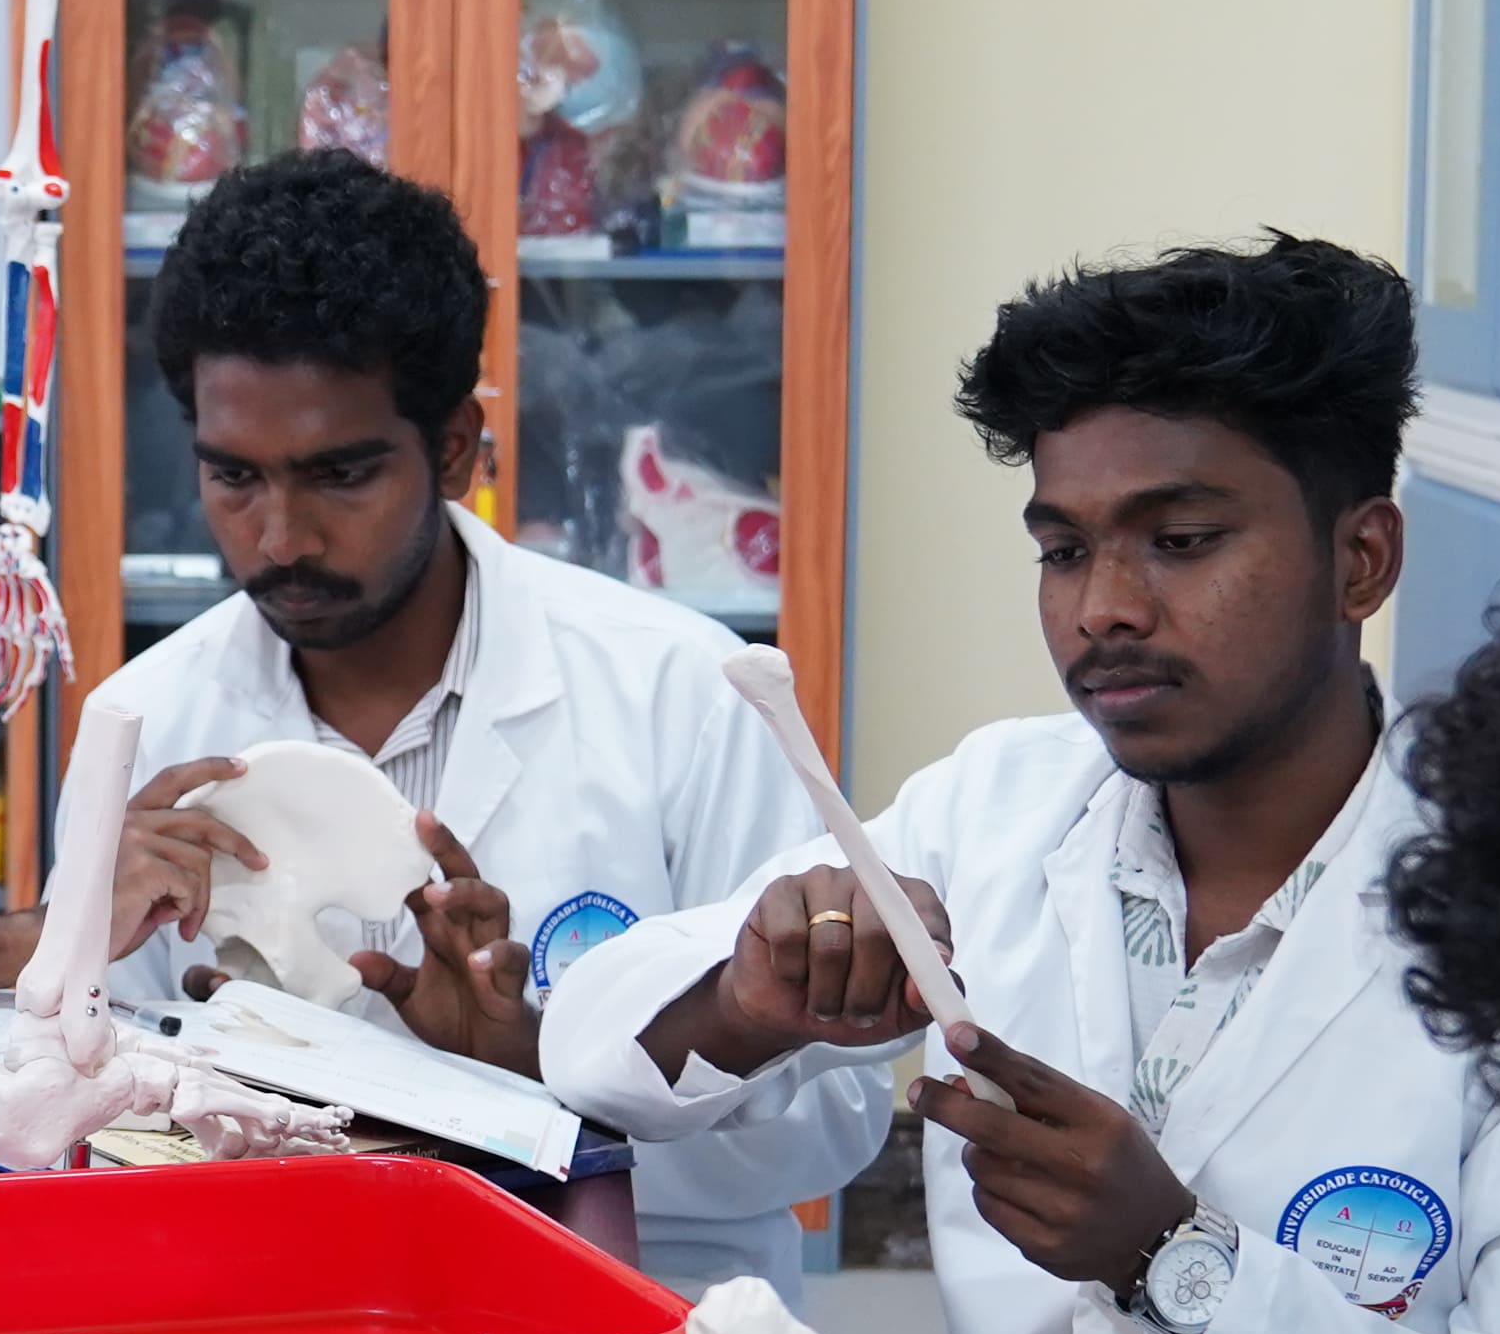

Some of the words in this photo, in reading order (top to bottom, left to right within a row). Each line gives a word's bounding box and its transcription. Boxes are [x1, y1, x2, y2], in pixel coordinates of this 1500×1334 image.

[1282, 1172, 1356, 1250] NIVERSIDADE
[1359, 1170, 1430, 1206] CATÓLICA
[1316, 1238, 1362, 1257] EDUCARE
[1331, 1254, 1342, 1263] IN
